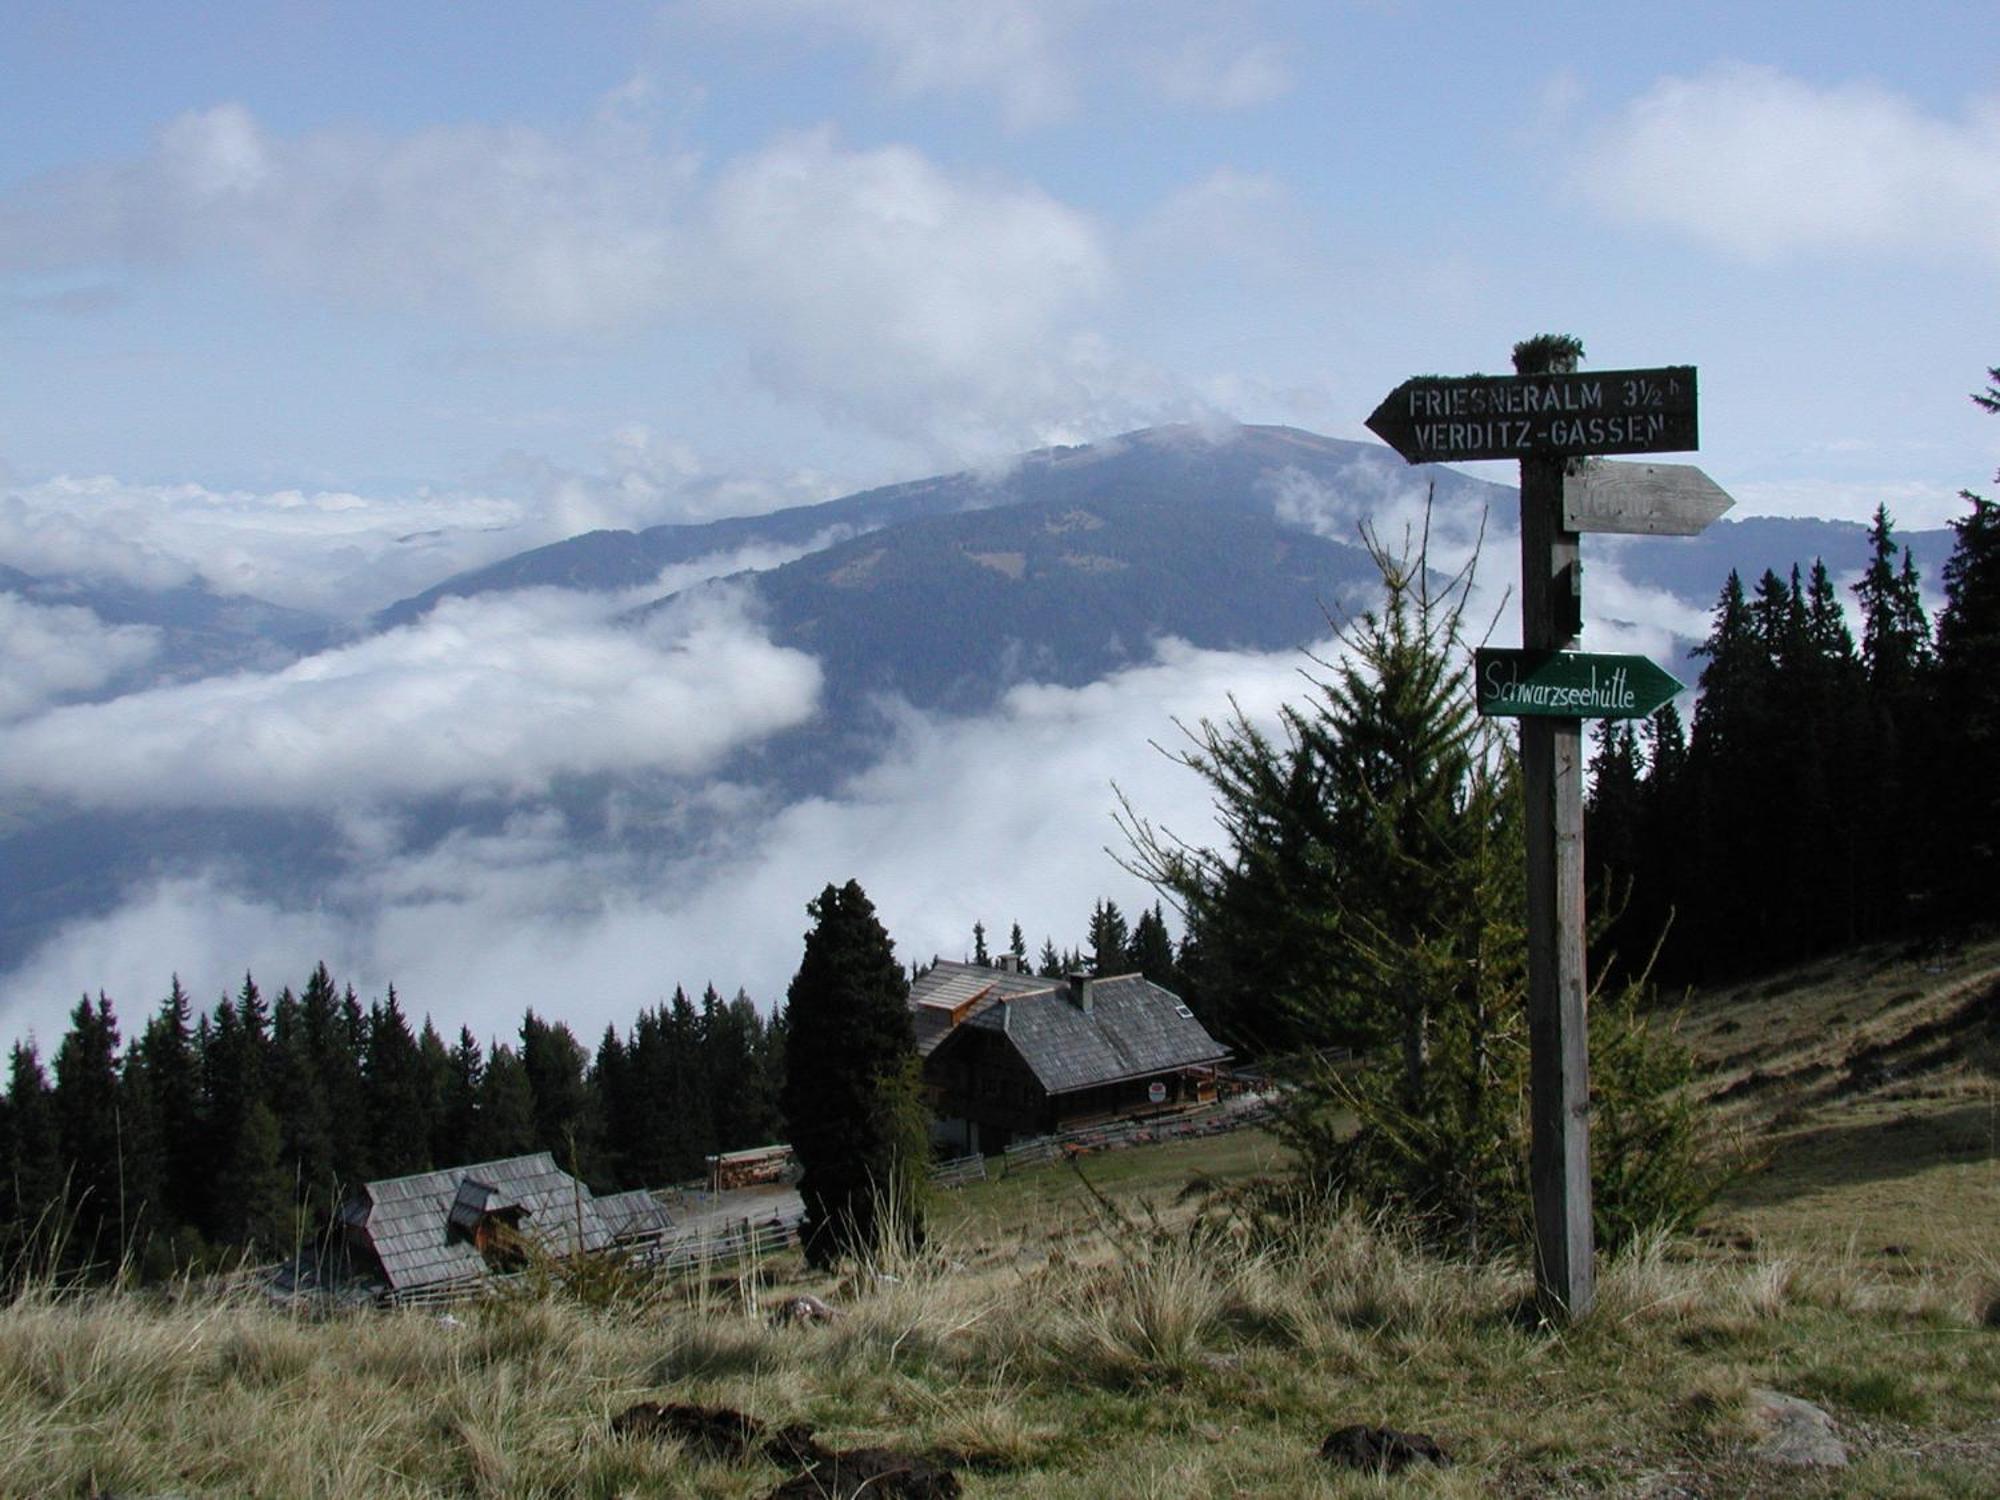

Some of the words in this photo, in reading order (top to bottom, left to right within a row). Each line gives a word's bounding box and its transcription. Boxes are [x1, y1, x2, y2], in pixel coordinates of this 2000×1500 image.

[1408, 381, 1602, 417] FRIESNERALM
[1414, 413, 1664, 450] VERDITZ-GASSEN
[1484, 660, 1635, 709] Schwarzseehütte
